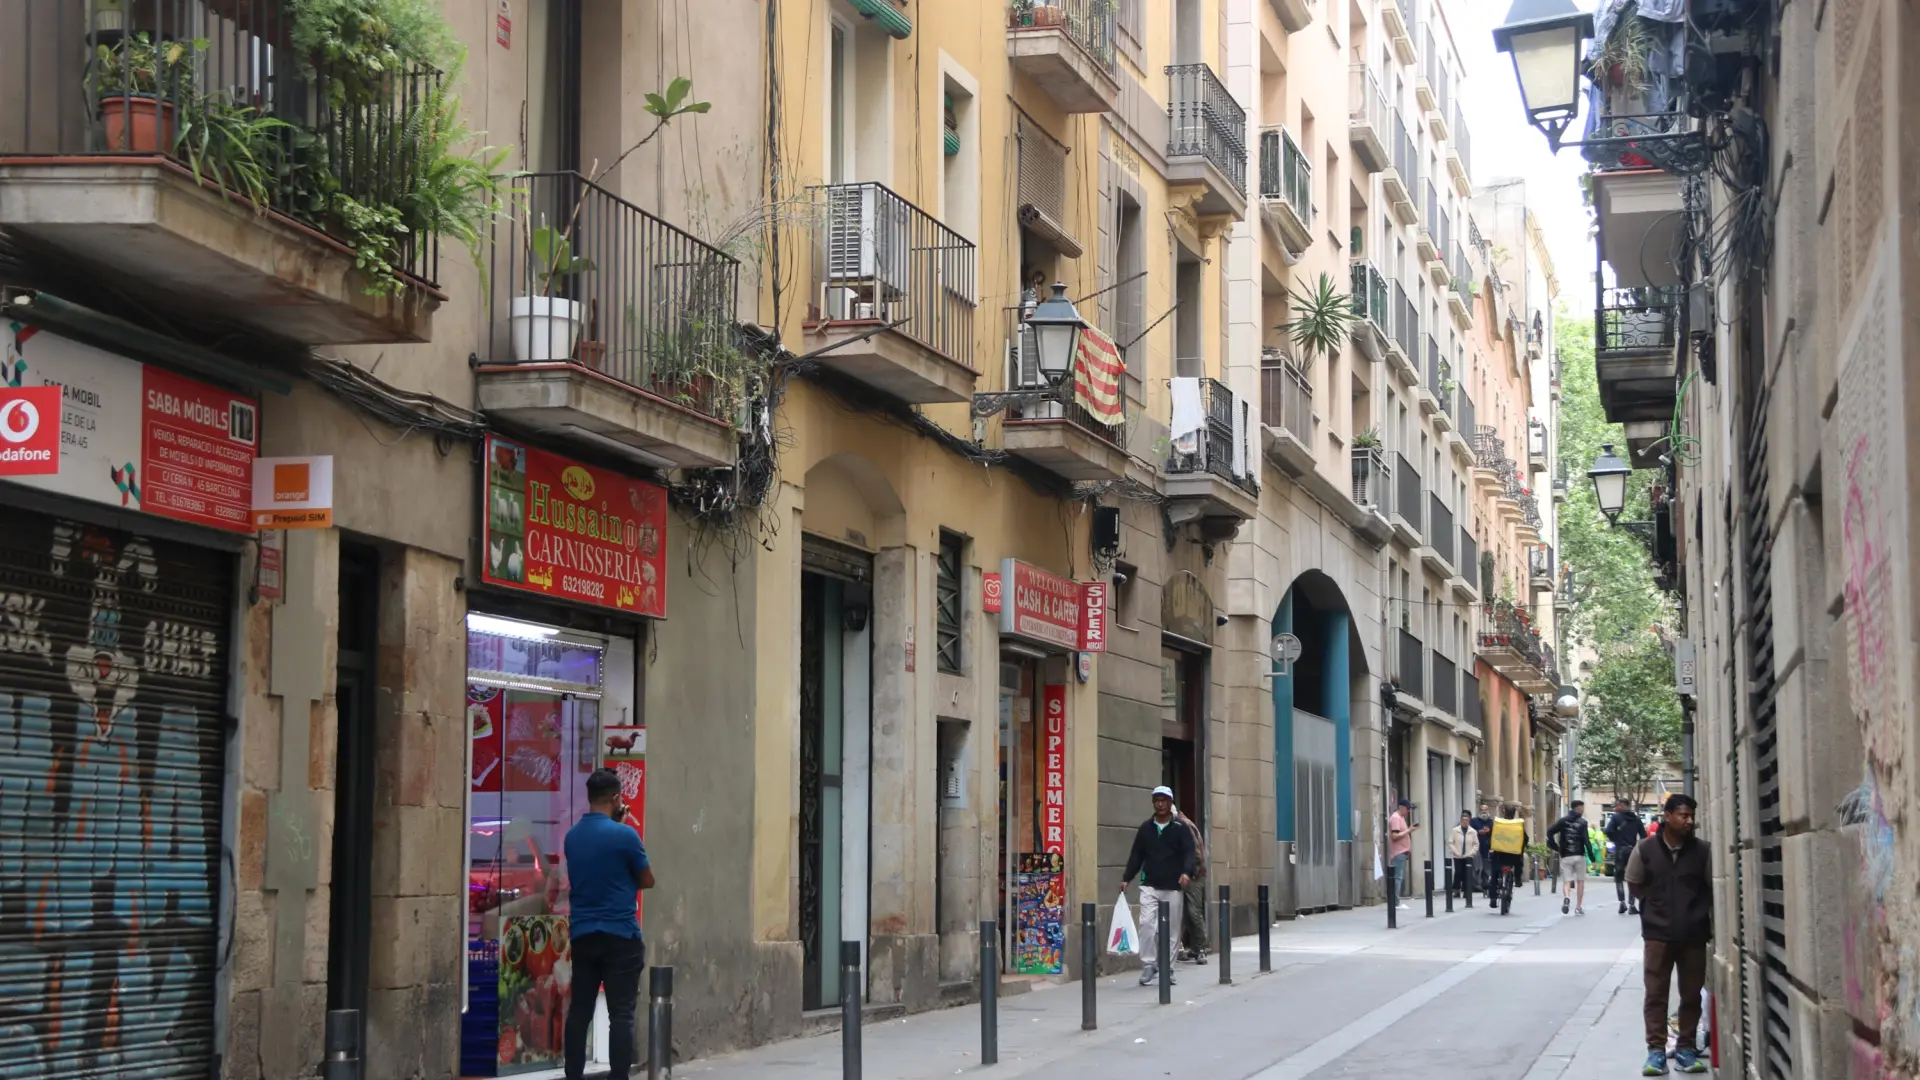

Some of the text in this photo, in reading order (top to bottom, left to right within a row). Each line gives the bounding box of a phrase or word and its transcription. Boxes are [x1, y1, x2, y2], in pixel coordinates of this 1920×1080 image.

[72, 386, 102, 408] MOBIL
[148, 389, 228, 430] SABA MÒBILS
[74, 414, 85, 429] DE
[87, 418, 96, 432] LA
[61, 430, 88, 449] ERA 45
[0, 447, 51, 461] dafone
[160, 446, 168, 458] DE
[170, 472, 187, 486] CERA
[205, 481, 241, 498] BARCELONA
[276, 490, 306, 500] orange
[273, 513, 326, 524] Prepaid SIM
[529, 480, 623, 546] Hussain
[528, 530, 643, 586] CARNISSERIA
[562, 575, 605, 599] 632198282
[1017, 585, 1080, 625] CASH & CARRY
[1086, 586, 1103, 640] SUPER
